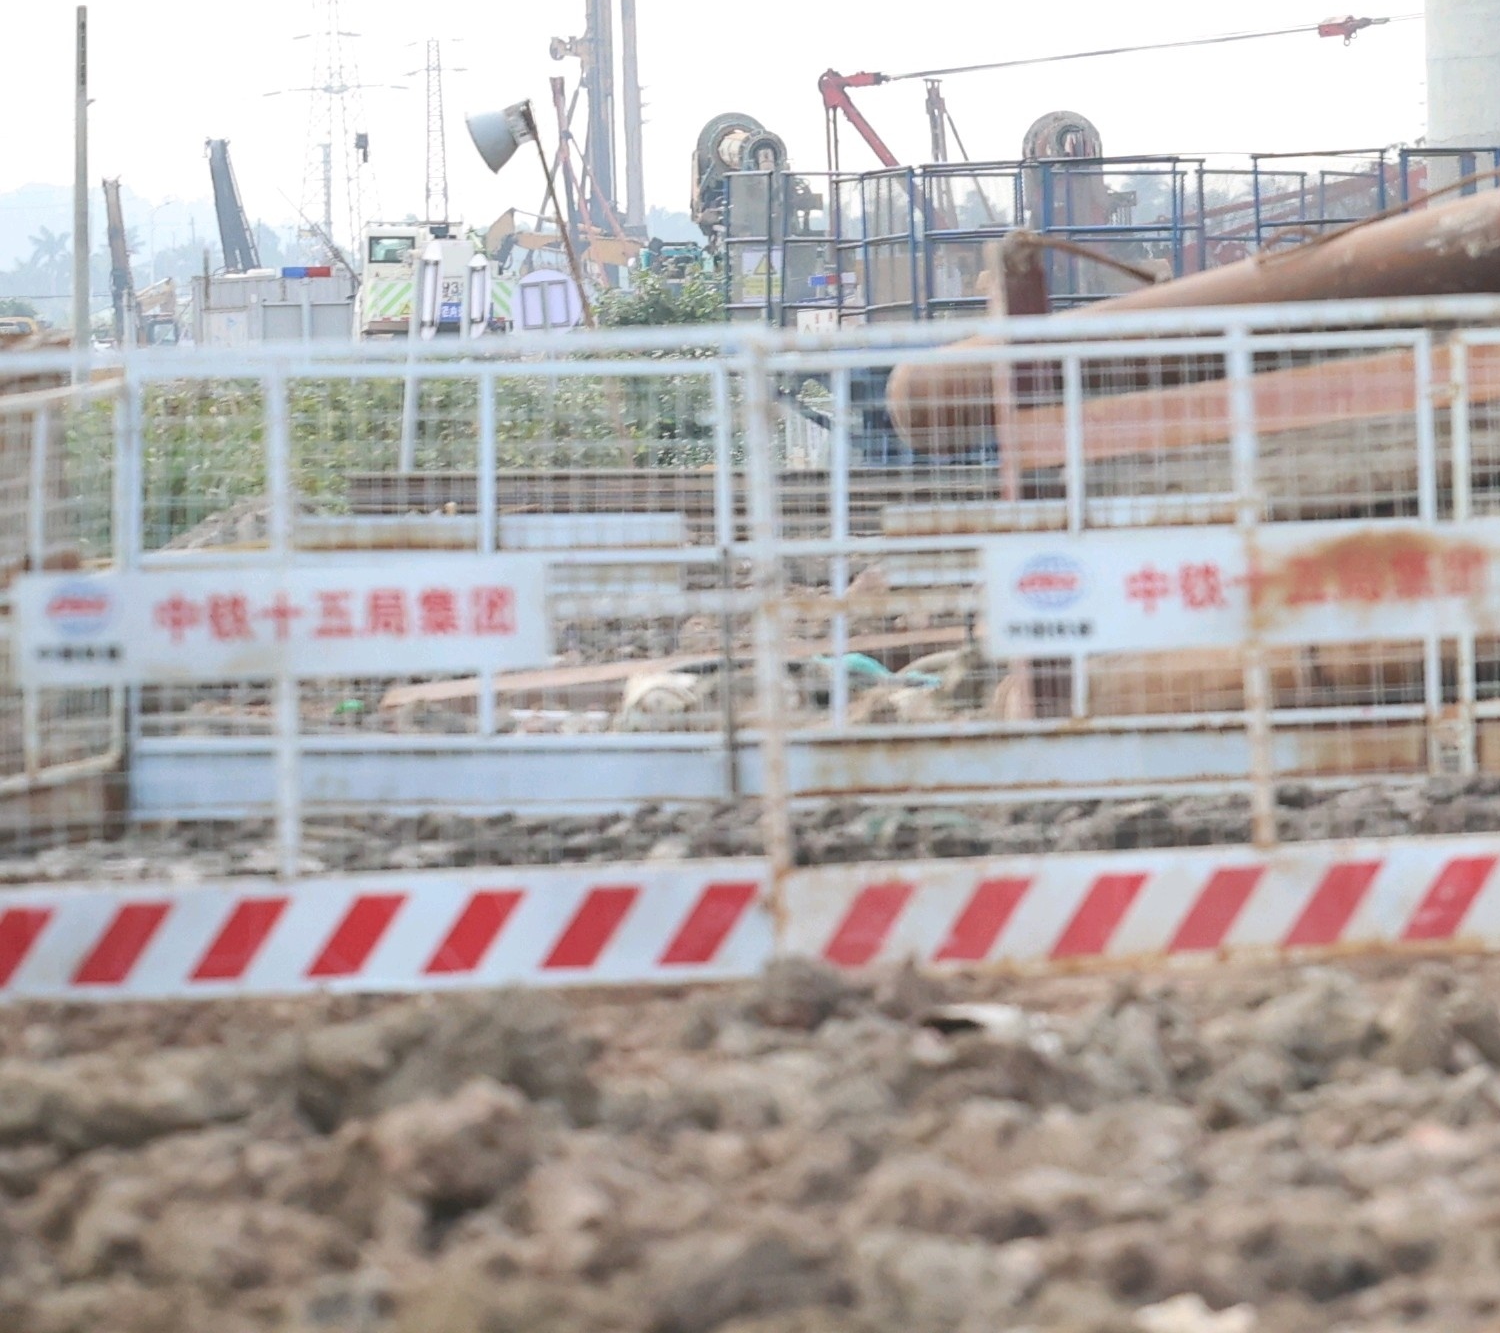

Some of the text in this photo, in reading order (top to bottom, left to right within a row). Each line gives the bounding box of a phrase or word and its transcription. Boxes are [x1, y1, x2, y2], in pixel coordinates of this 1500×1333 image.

[152, 584, 517, 644] 中铁十五局集团
